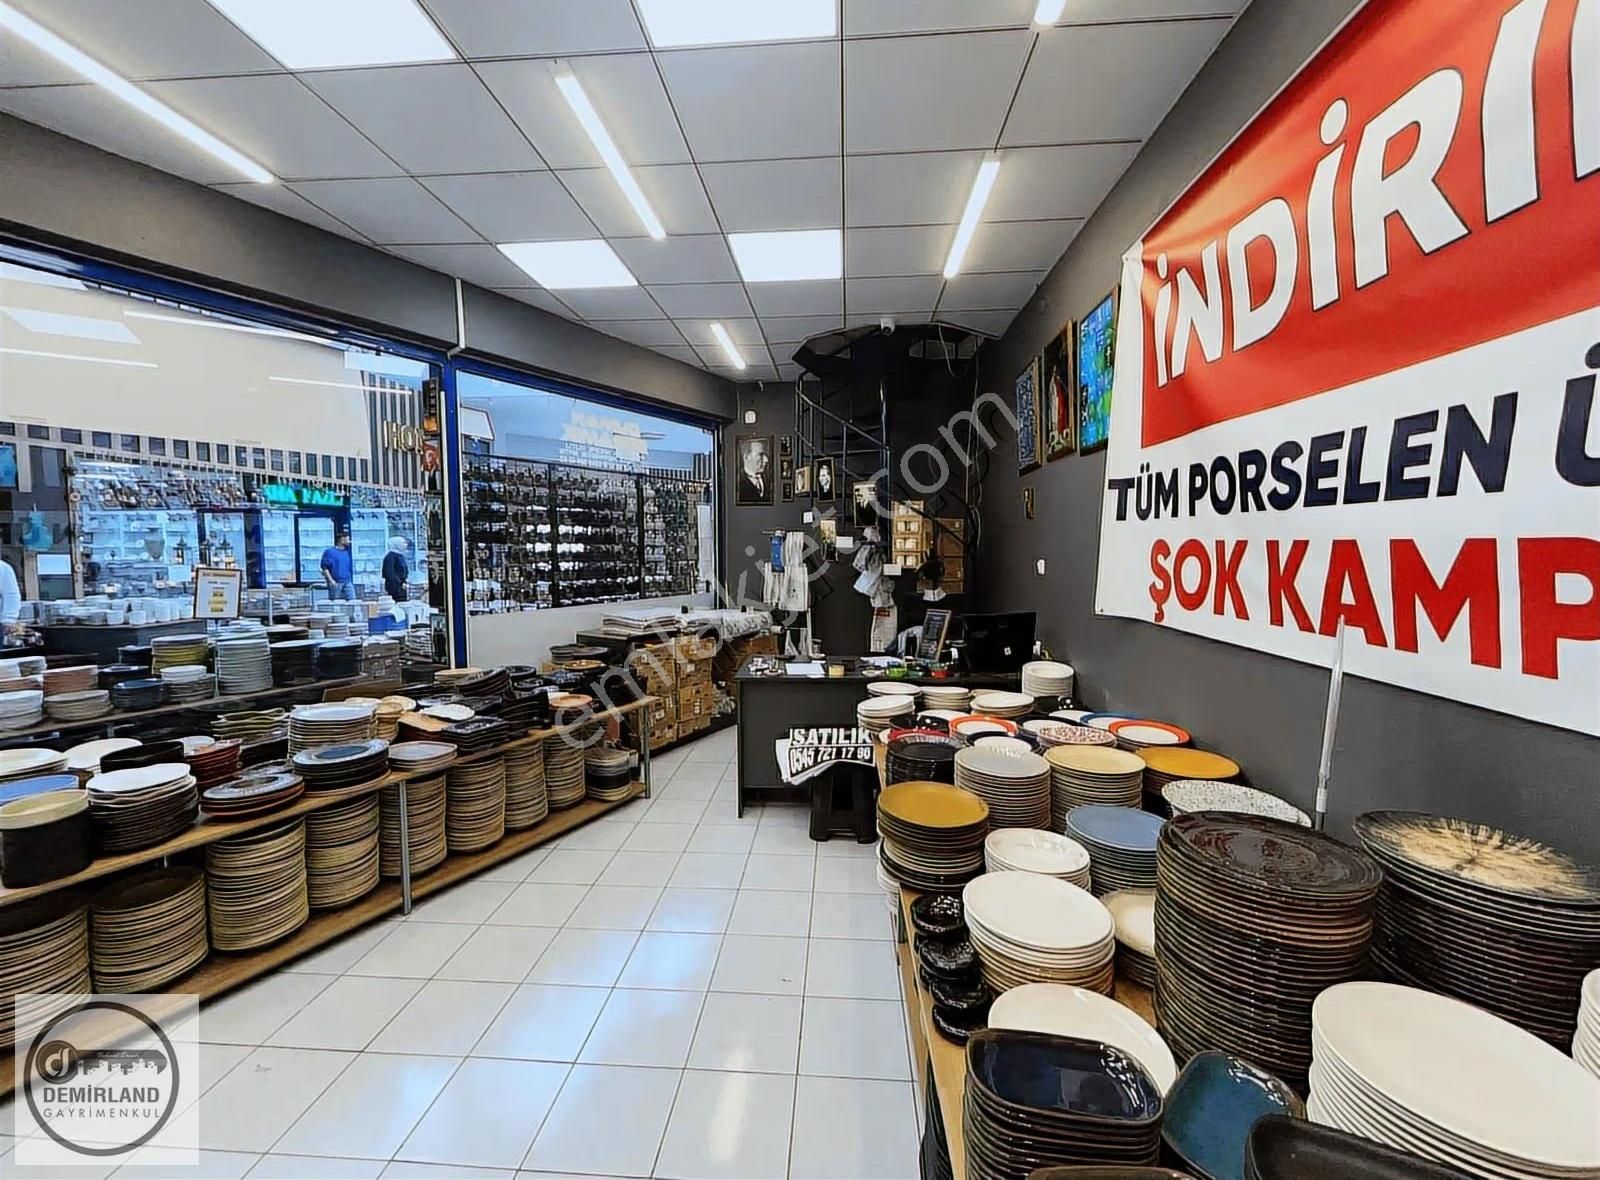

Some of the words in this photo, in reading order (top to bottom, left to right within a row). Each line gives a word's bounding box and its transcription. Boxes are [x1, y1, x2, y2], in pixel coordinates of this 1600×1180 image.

[1107, 463, 1179, 521] TÜM
[1188, 392, 1518, 517] PORSELEN
[1149, 538, 1249, 623] ŞOK
[1266, 537, 1600, 679] KAMP
[793, 727, 872, 746] SATILIK
[818, 747, 836, 762] 721
[841, 747, 855, 759] 17
